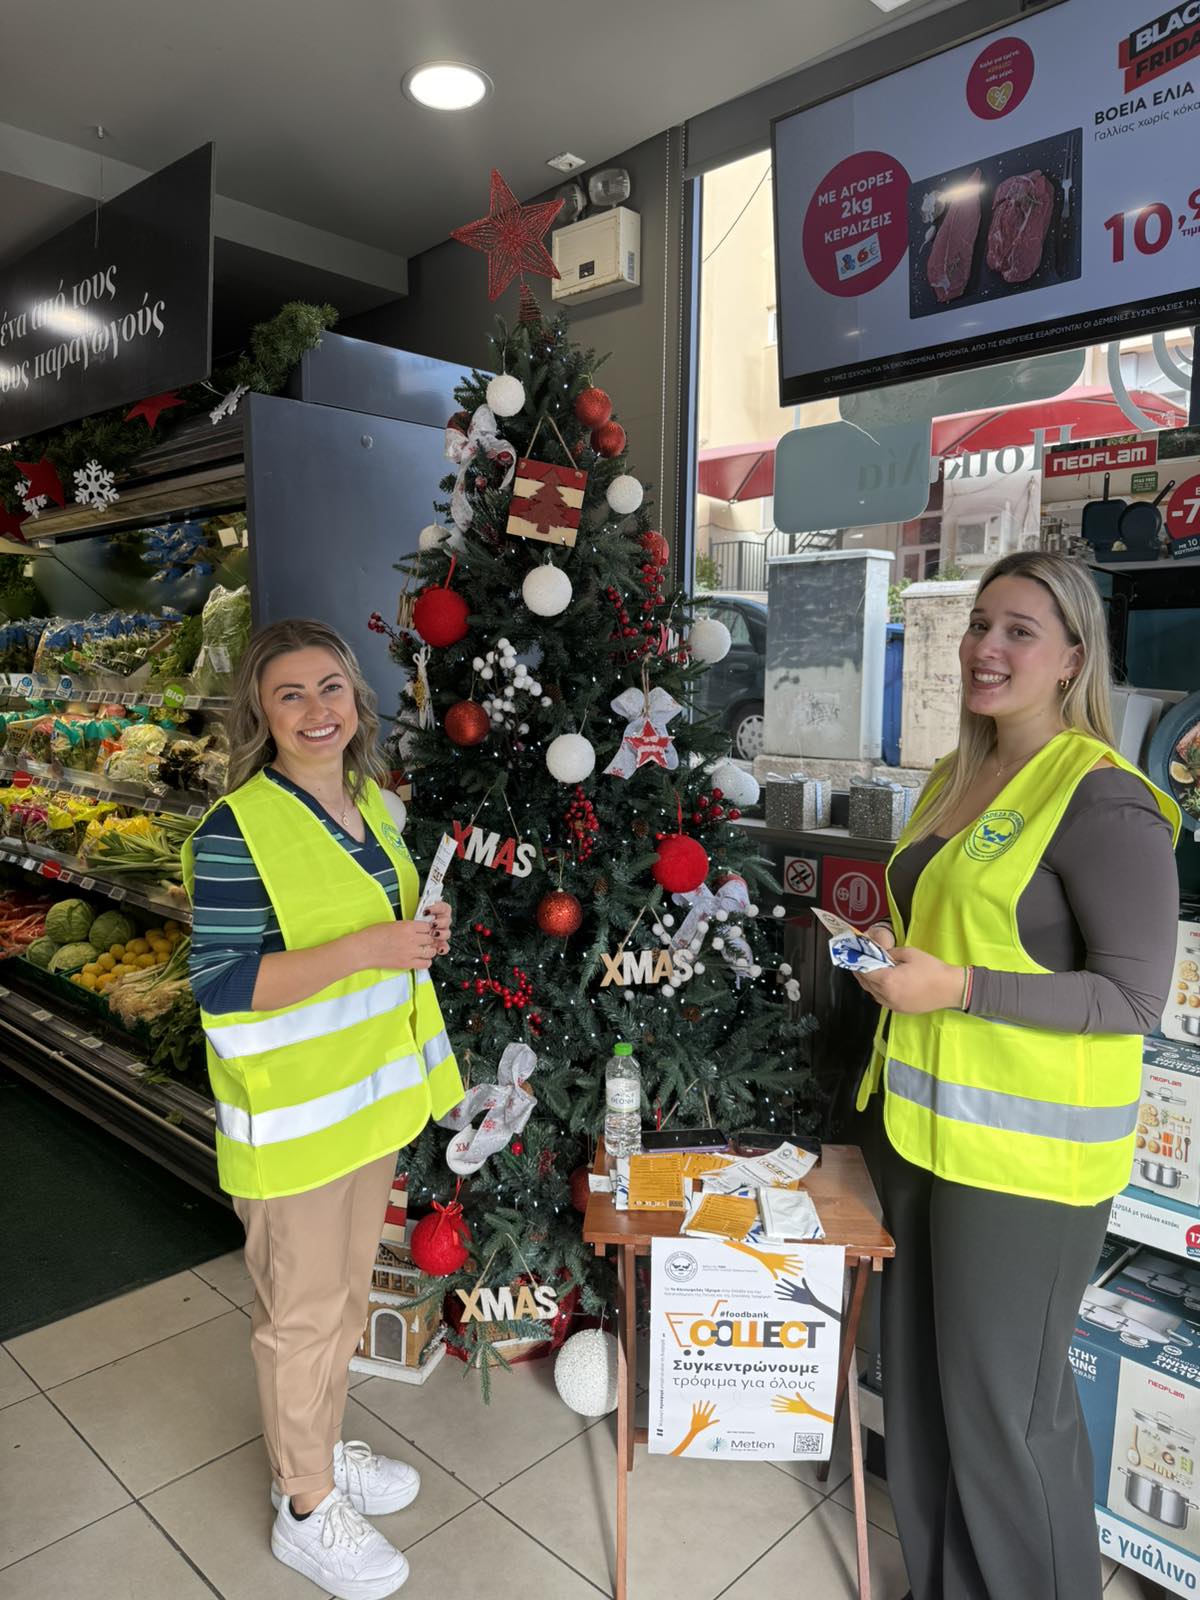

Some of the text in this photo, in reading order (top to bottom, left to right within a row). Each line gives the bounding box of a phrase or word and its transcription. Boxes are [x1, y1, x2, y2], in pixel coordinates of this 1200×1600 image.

[1095, 81, 1194, 126] ΒΟΕΙΑ ΕΛΙΑ
[1094, 121, 1135, 142] Γαλλίας
[1138, 110, 1170, 129] χωρίς
[818, 170, 894, 207] ΜΕ ΑΓΟΡΕΣ
[841, 197, 873, 219] 2kg
[824, 211, 892, 245] ΚΕΡΔΙΖΕΙΣ
[72, 265, 117, 309] τους
[33, 292, 166, 381] παραγωγούς
[971, 343, 987, 352] ΑΠΟ
[988, 340, 998, 349] ΤΙΣ
[999, 332, 1034, 346] ΕΝΕΡΓΕΙΕΣ
[1035, 321, 1082, 339] ΕΞΑΙΡΟΥΝΤΑΙ
[1093, 312, 1130, 327] ΔΕΜΕΝΕΣ
[1131, 301, 1183, 318] ΣΥΣΚΕΥΑΣΙΕΣ
[1188, 538, 1198, 547] 10
[165, 688, 185, 703] BIO
[453, 819, 537, 878] XMAS
[600, 949, 694, 987] XMAS
[455, 1285, 559, 1323] XMAS
[719, 1310, 769, 1319] #foodbank
[689, 1319, 826, 1349] COLLECT
[672, 1359, 819, 1377] Συγκεντρώνουμε
[672, 1374, 816, 1392] τρόφιμα για όλους
[1157, 1356, 1200, 1377] OKING
[730, 1440, 775, 1449] Metlen
[1098, 1525, 1197, 1590] ε γυάλινο
